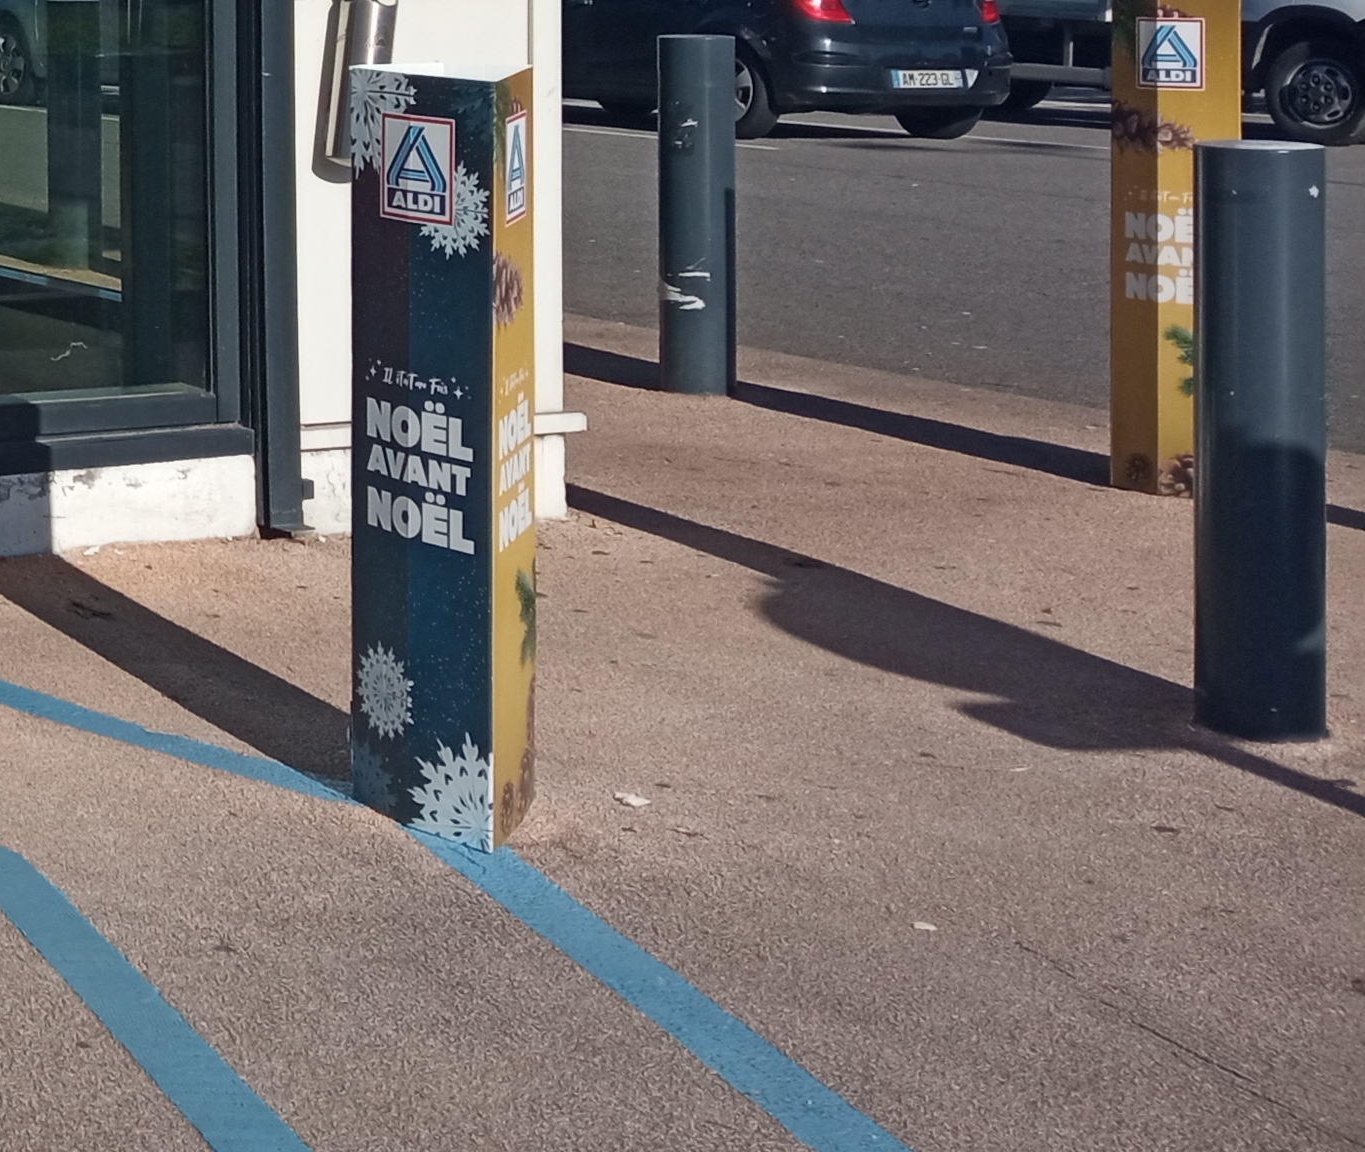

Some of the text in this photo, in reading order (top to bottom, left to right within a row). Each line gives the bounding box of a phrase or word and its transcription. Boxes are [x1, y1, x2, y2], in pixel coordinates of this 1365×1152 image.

[1147, 70, 1192, 82] ALDI
[391, 191, 441, 213] ALDI
[509, 188, 524, 211] ALDI
[1125, 207, 1194, 244] NOË
[1125, 242, 1194, 267] AVAN
[1125, 268, 1194, 305] NOË
[366, 396, 474, 463] NOËL
[499, 391, 532, 462] NOËL
[366, 444, 471, 497] AVANT
[499, 441, 532, 497] AVANT
[367, 485, 475, 555] NOËL
[499, 480, 533, 553] NOËL
